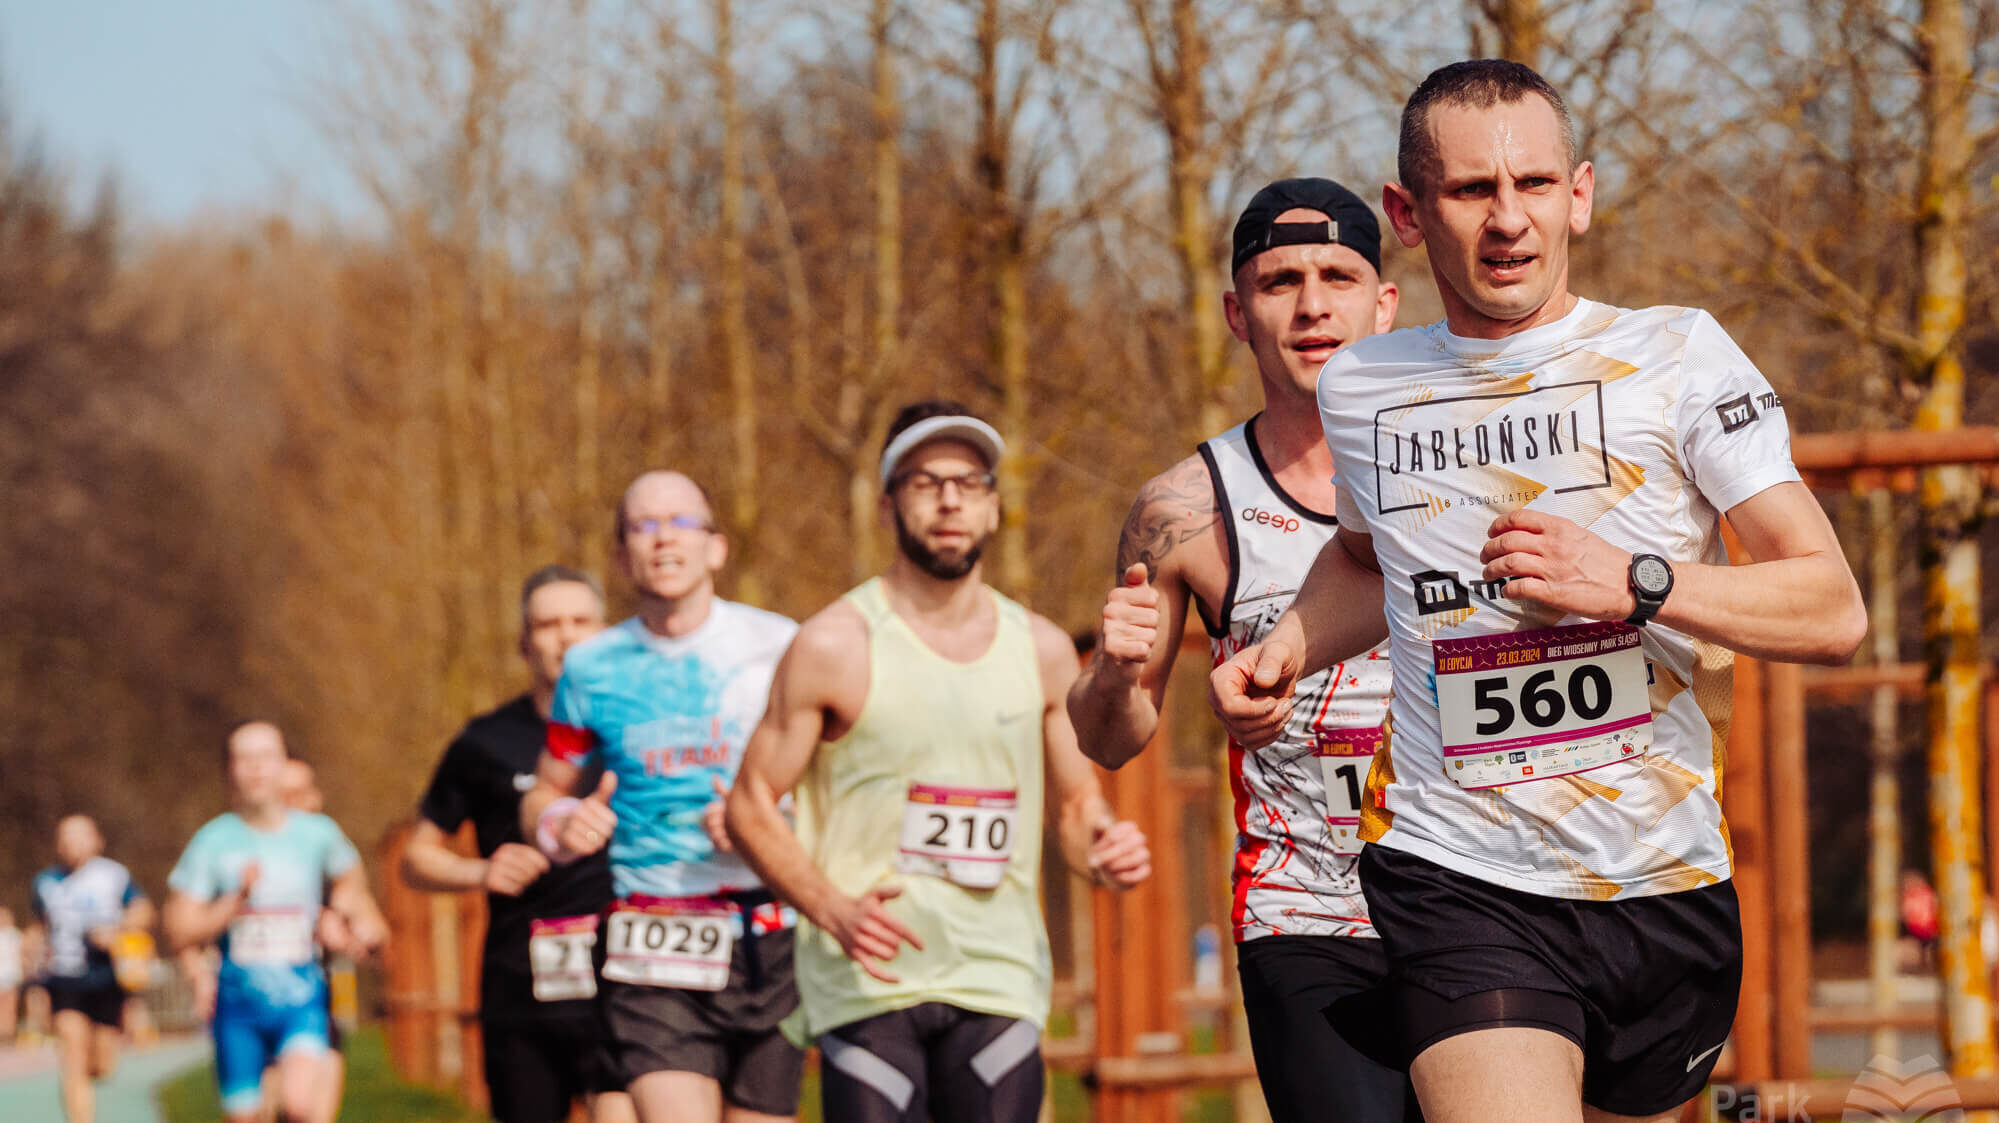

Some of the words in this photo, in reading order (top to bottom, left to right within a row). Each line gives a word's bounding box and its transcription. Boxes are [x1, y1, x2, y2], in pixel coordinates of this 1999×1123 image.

[1389, 410, 1580, 475] JABŁOŃSKI
[1460, 490, 1540, 507] ASSOCIATES
[1242, 507, 1300, 534] deep
[1496, 647, 1541, 666] 23.03.2024
[1600, 637, 1617, 651] PARK
[1474, 664, 1613, 736] 560
[643, 742, 731, 777] TEAM
[925, 813, 1009, 851] 210
[623, 920, 719, 955] 1029
